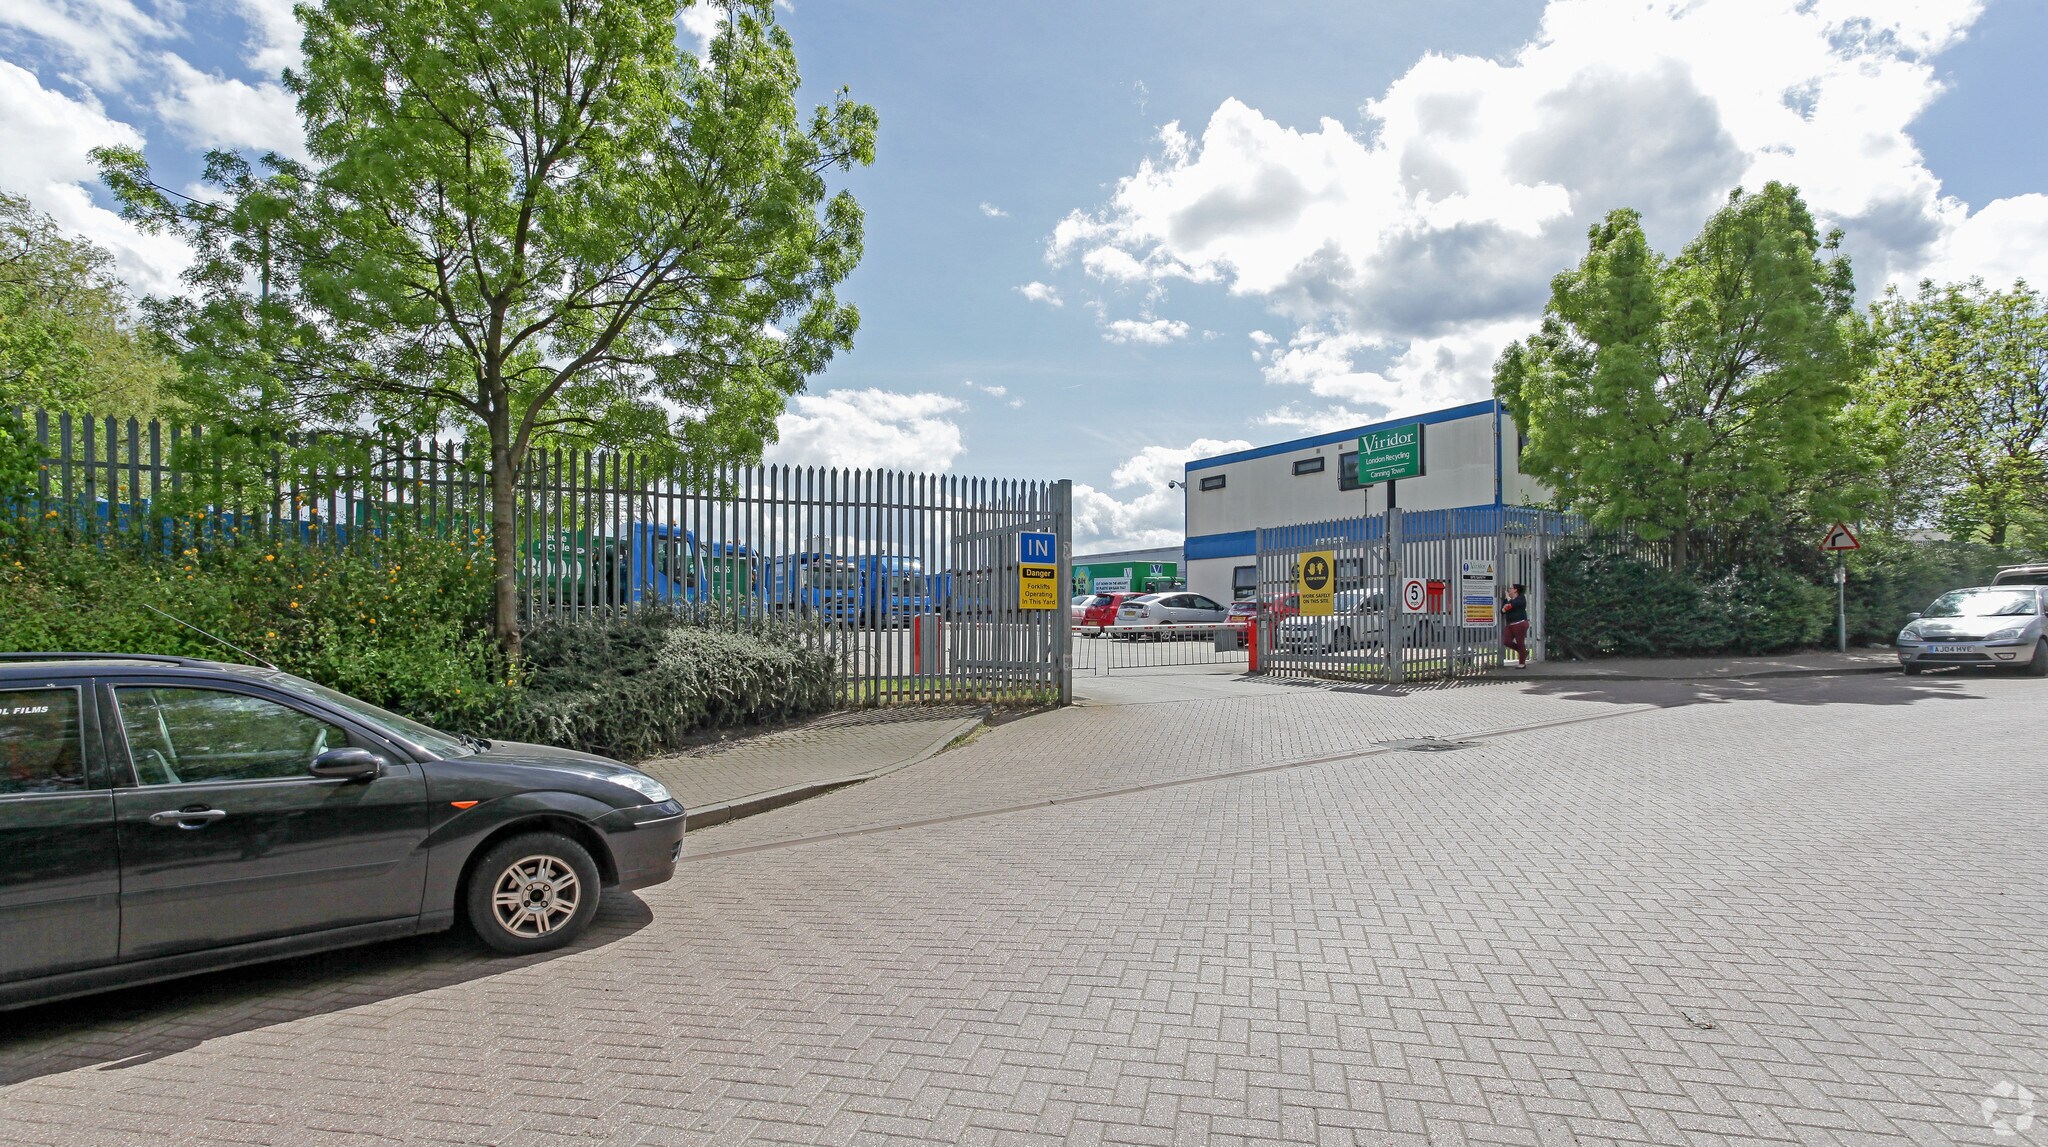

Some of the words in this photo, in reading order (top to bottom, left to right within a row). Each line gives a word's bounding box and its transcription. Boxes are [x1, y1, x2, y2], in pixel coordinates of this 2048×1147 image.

[1361, 432, 1414, 455] Viridor
[1366, 456, 1386, 465] London
[1386, 452, 1410, 462] Recycling
[1370, 470, 1390, 478] Canning
[1028, 538, 1048, 557] IN
[1026, 568, 1051, 578] Danger
[1411, 585, 1418, 600] 5
[13, 706, 49, 714] FILMS
